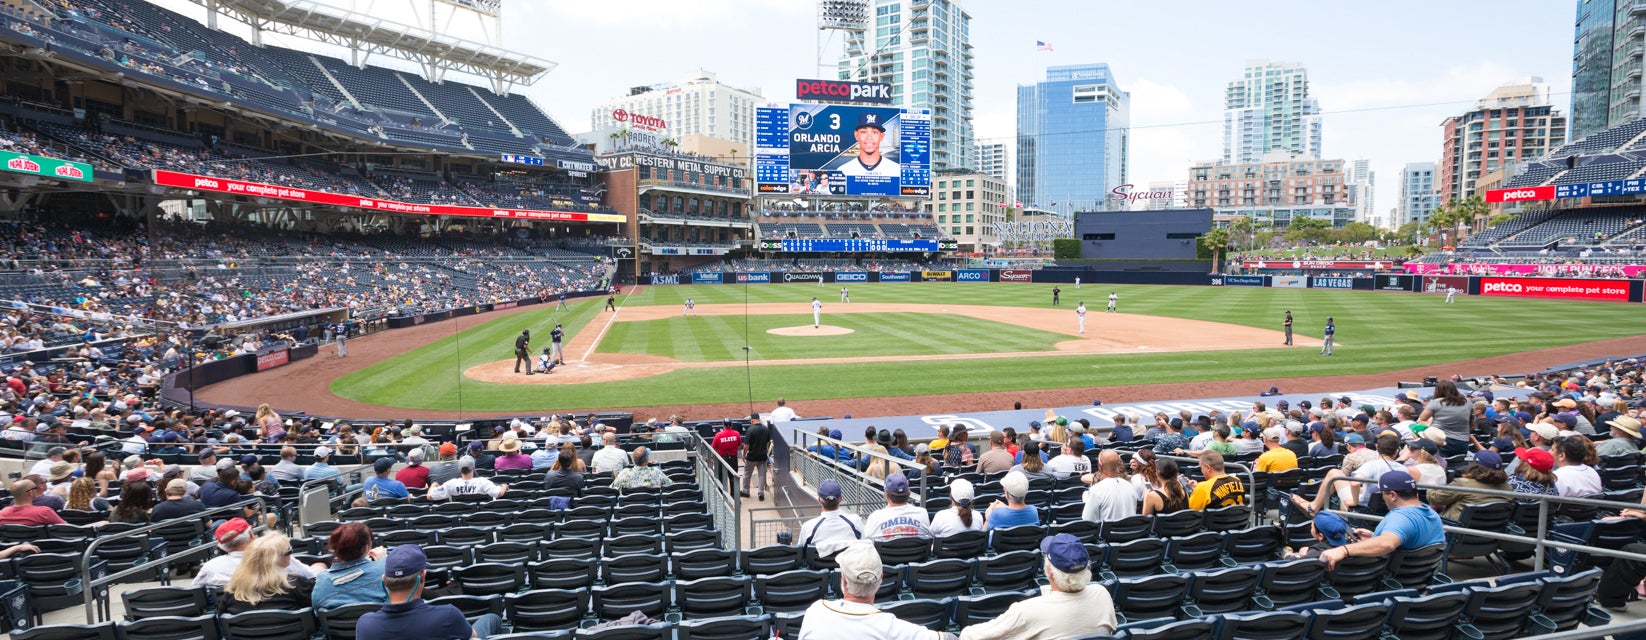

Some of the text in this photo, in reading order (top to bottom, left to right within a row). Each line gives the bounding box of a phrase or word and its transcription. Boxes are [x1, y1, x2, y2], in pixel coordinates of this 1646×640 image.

[630, 112, 666, 128] TOYOTA
[830, 114, 840, 130] 3
[628, 132, 656, 148] PADRES
[794, 134, 840, 143] ORLANDO
[810, 144, 840, 153] ARCIA
[562, 160, 592, 171] CUTWATER
[636, 154, 674, 169] WESTERN
[678, 161, 702, 173] METAL
[704, 164, 730, 176] SUPPLY
[733, 169, 744, 178] CO.
[195, 178, 305, 198] petco your complete pet store
[1112, 184, 1173, 204] Sycuan
[1504, 190, 1536, 200] petco
[992, 220, 1074, 232] NATIONA
[652, 276, 679, 284] ASML
[785, 273, 820, 281] QUALCOMM
[1003, 271, 1028, 280] Sycuan
[1328, 279, 1351, 288] VEGAS
[1484, 282, 1522, 292] petco
[257, 351, 286, 365] petco.com
[1213, 481, 1244, 499] WINFIELD
[881, 516, 921, 529] OMBAC
